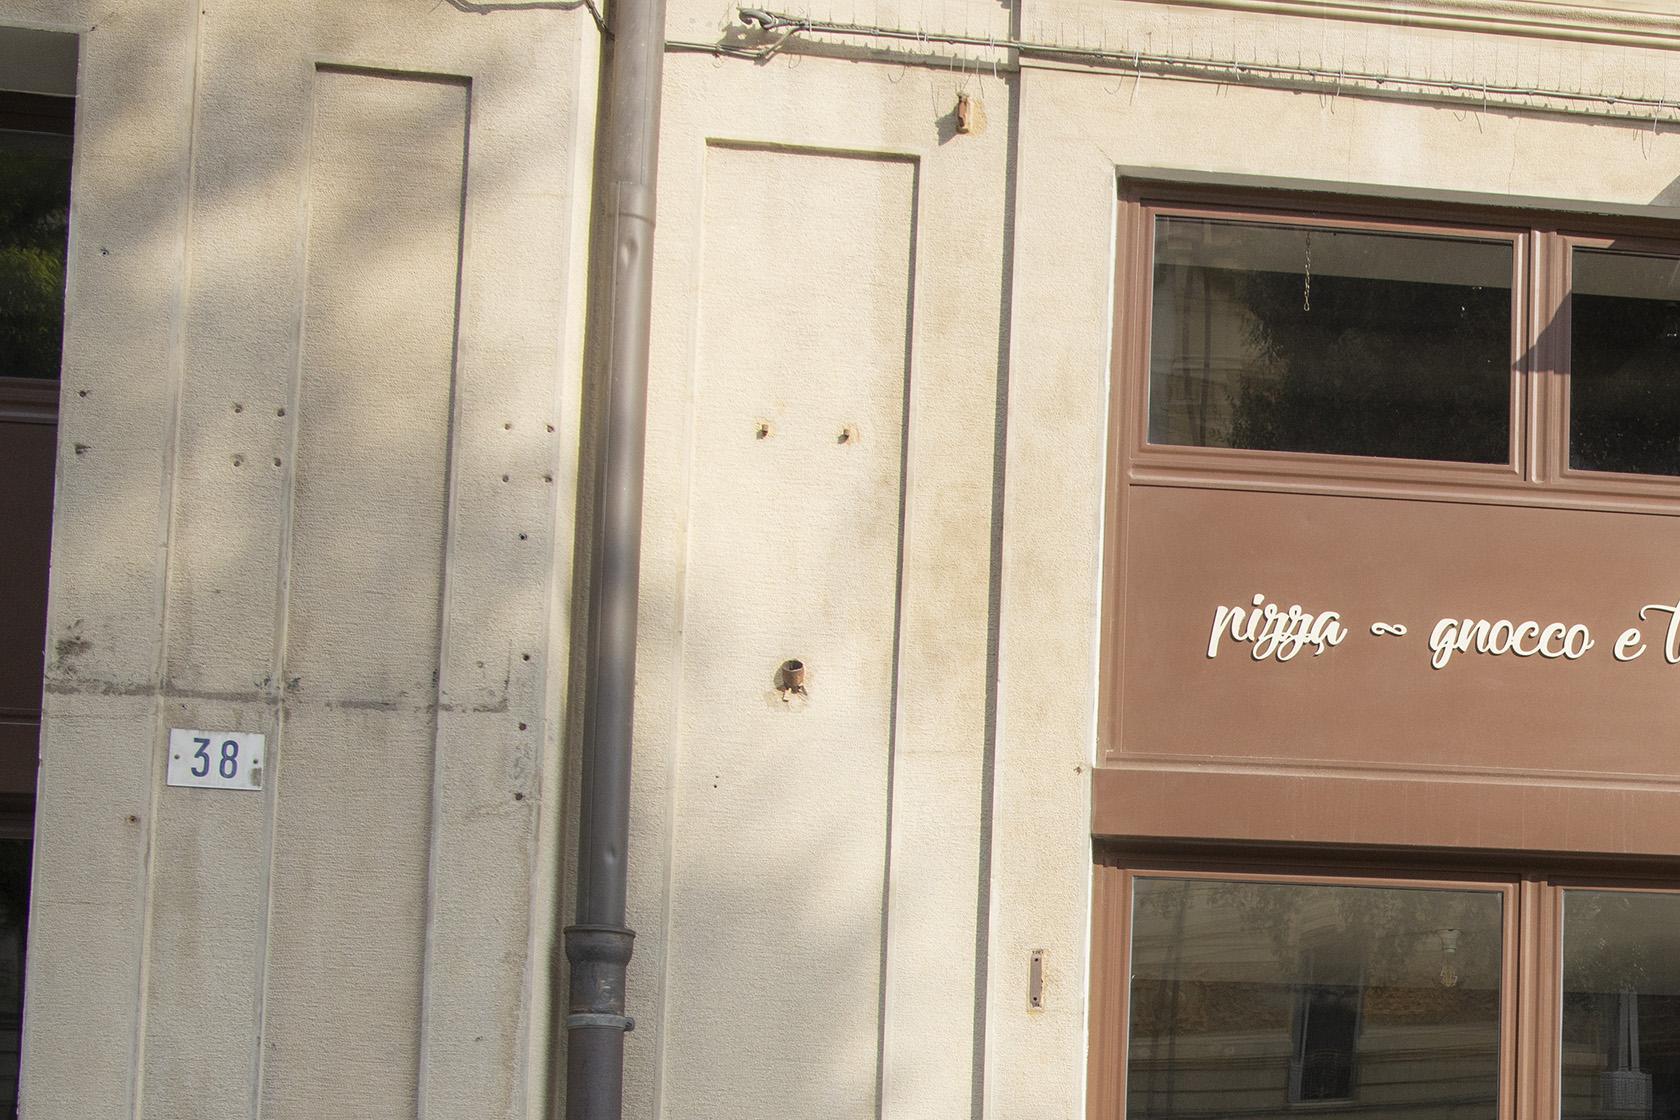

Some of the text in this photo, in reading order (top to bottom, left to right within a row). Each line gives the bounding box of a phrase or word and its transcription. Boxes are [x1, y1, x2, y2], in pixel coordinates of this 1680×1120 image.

[1207, 593, 1348, 661] pizza
[1429, 618, 1595, 669] gnocco
[1613, 628, 1647, 661] e
[191, 737, 239, 779] 38
